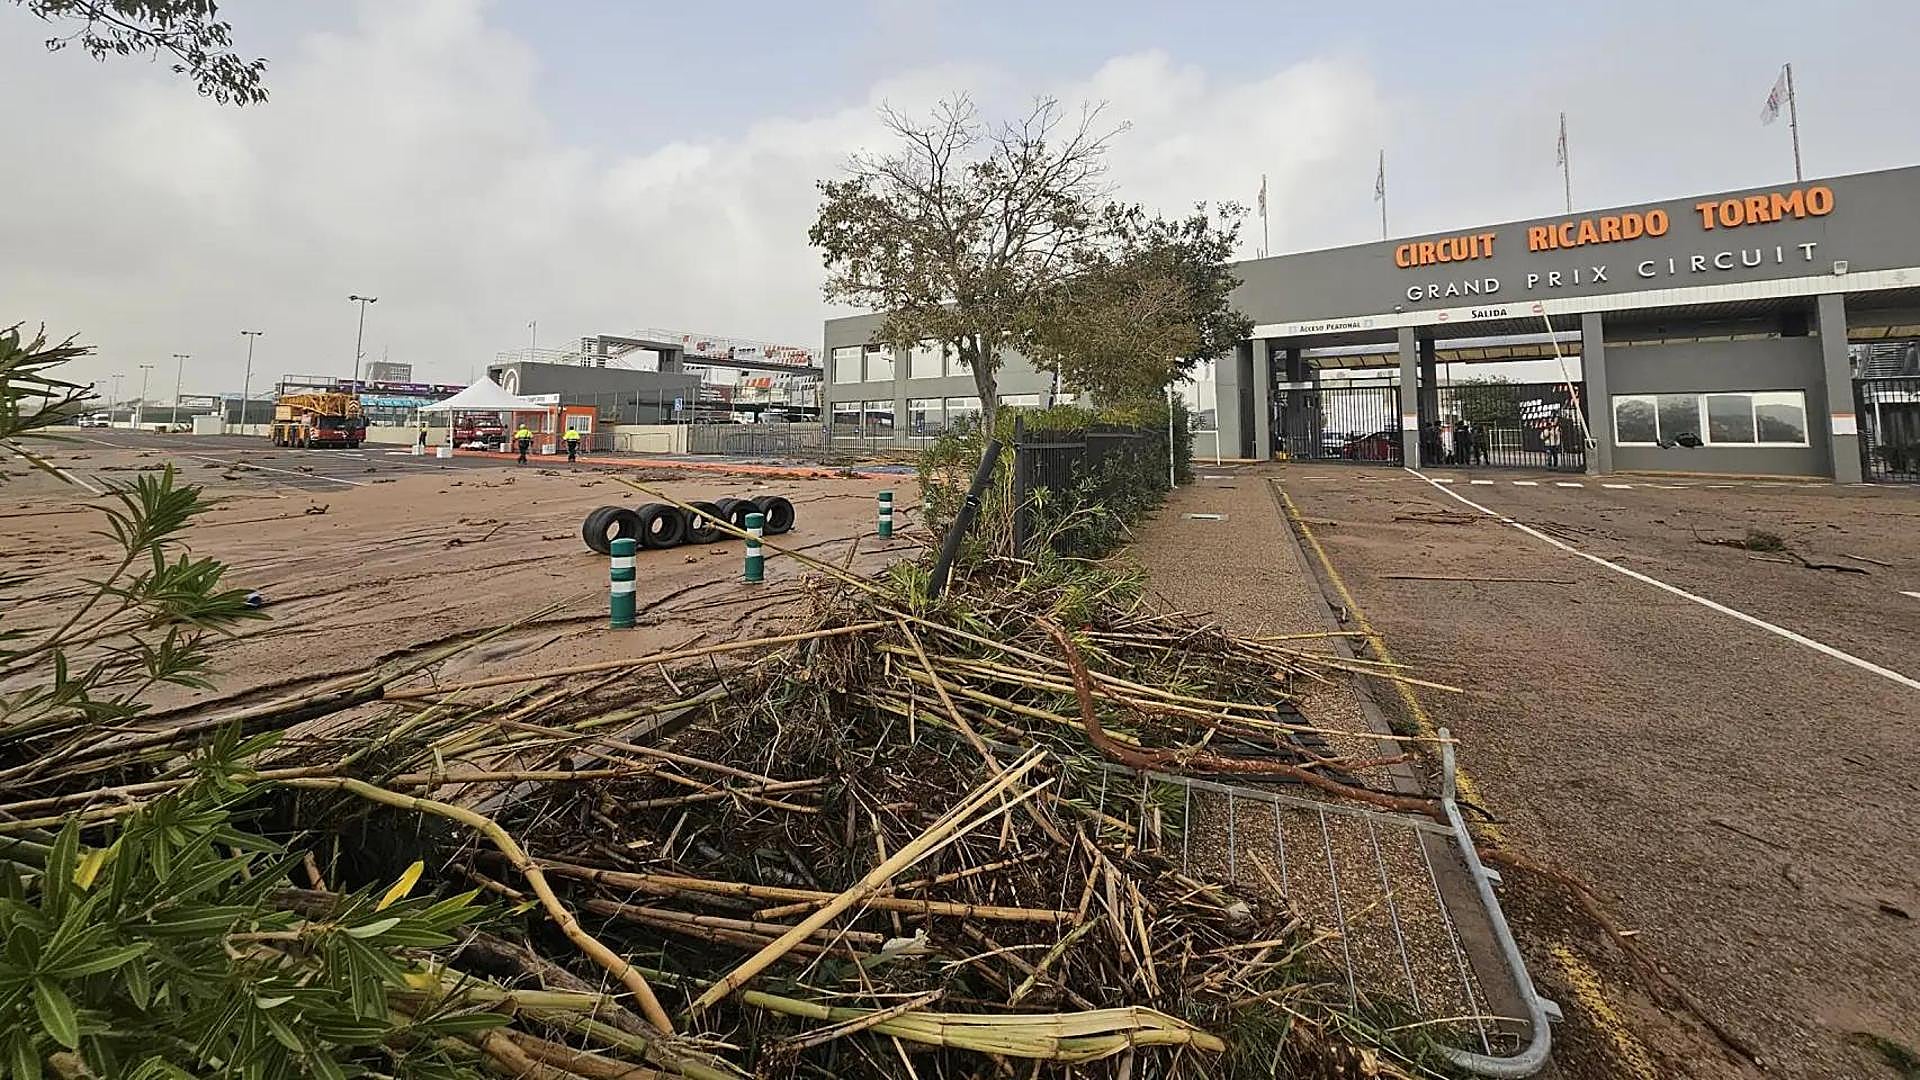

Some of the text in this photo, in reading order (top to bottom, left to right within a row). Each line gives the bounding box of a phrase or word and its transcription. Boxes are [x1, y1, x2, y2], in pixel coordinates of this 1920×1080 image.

[1395, 186, 1835, 268] CIRCUIT RICARDO TORMO
[1407, 242, 1818, 302] GRAND PRIX CIRCUIT
[1471, 308, 1508, 319] SALIDA
